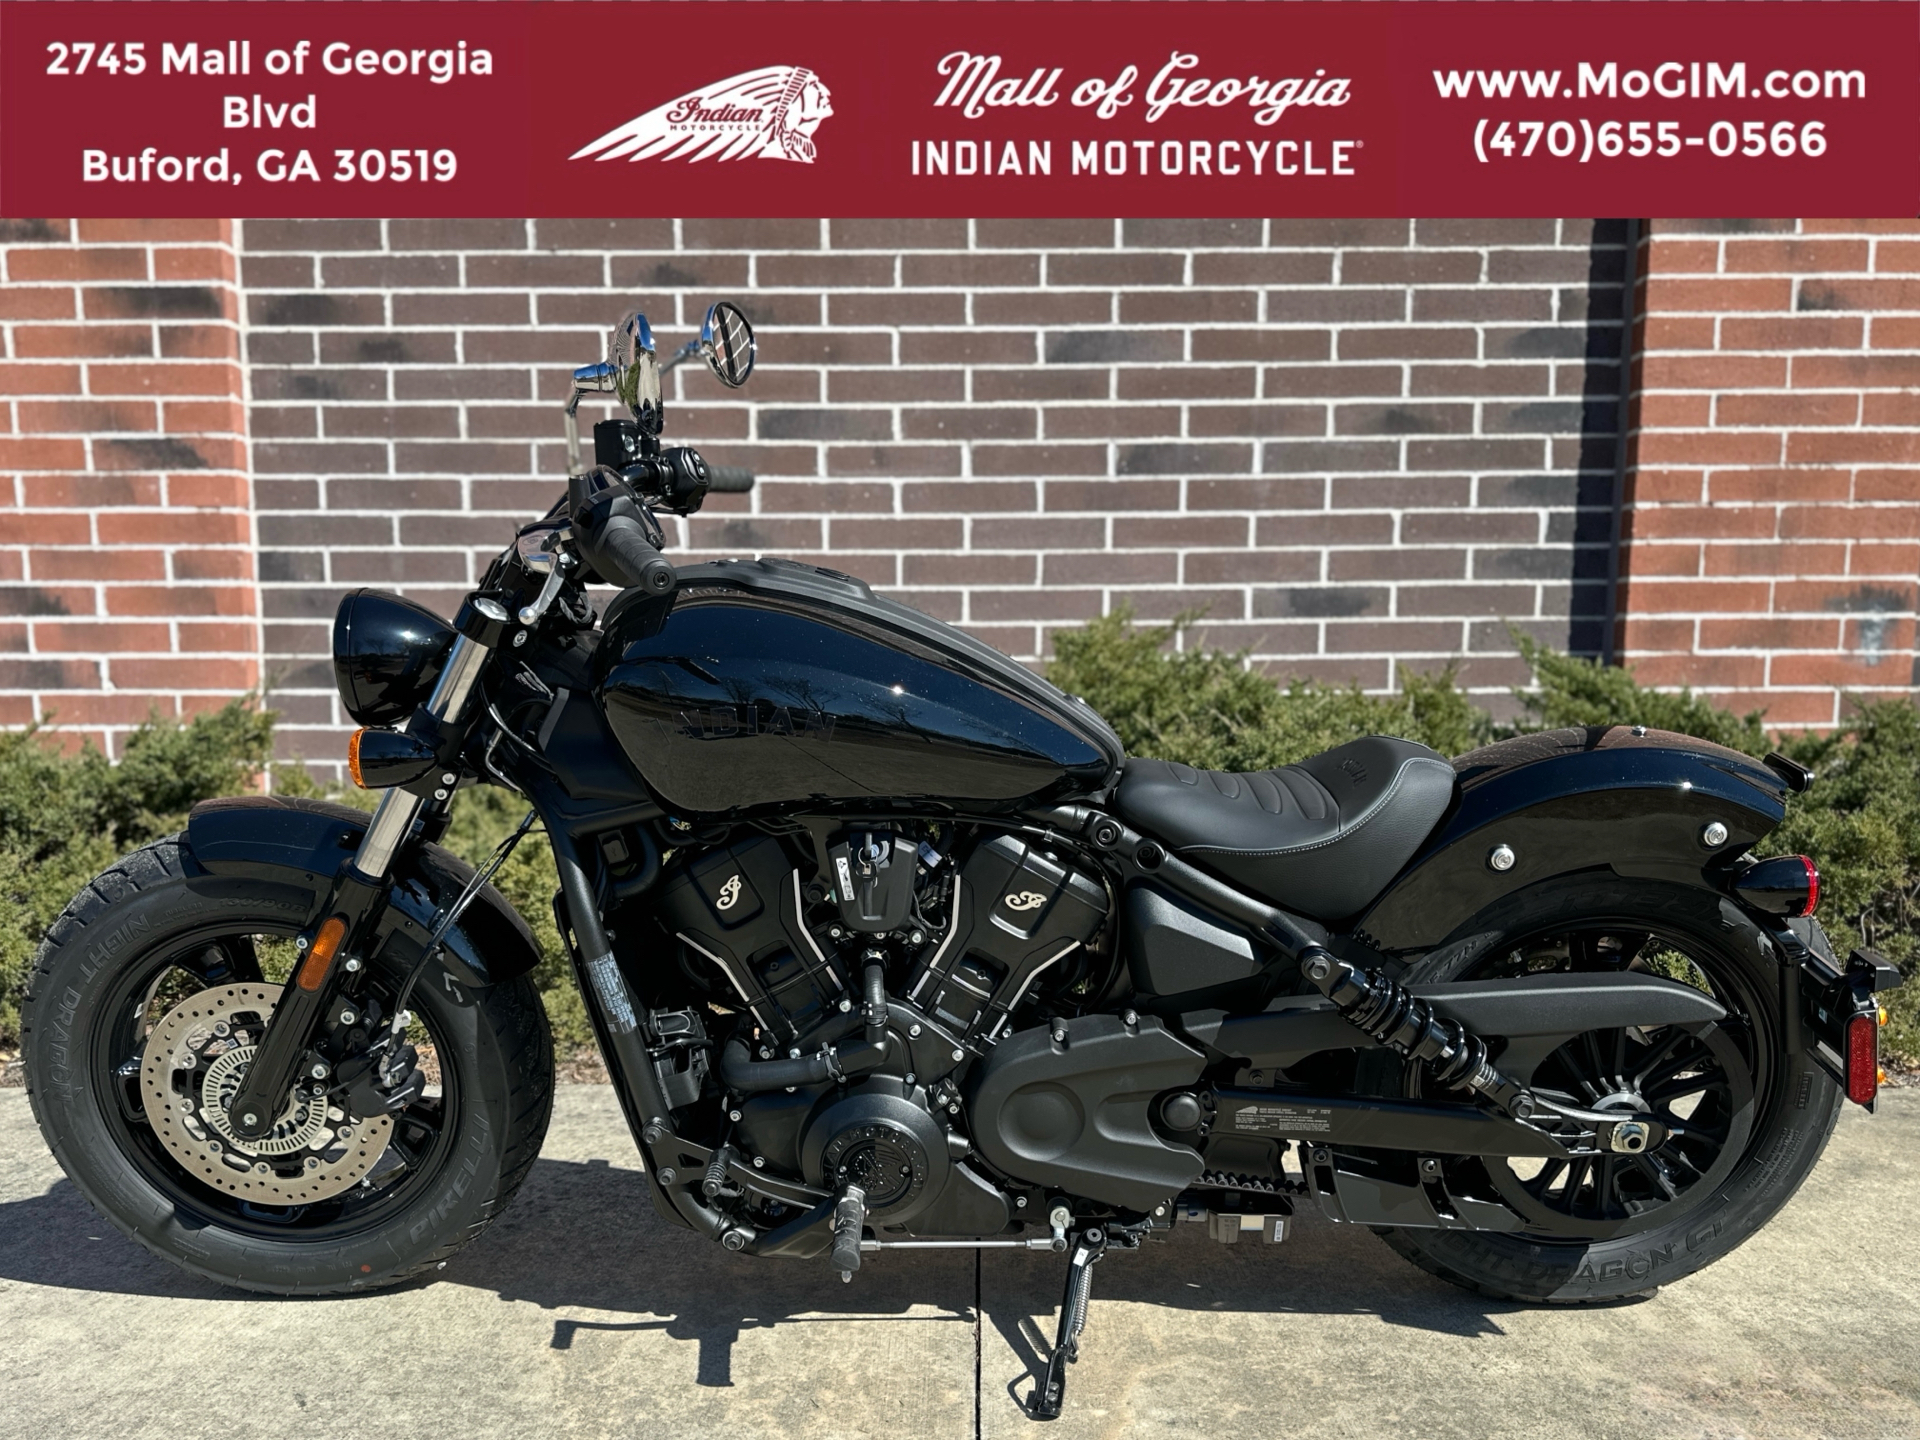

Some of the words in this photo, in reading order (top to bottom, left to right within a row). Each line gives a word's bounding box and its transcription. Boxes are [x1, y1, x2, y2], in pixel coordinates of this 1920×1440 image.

[78, 912, 152, 985] NIGHT
[49, 985, 83, 1104] DRAGON
[408, 1112, 491, 1245] PIRELLI
[1433, 1230, 1514, 1271] IGHT
[1521, 1242, 1678, 1285] DRAGON
